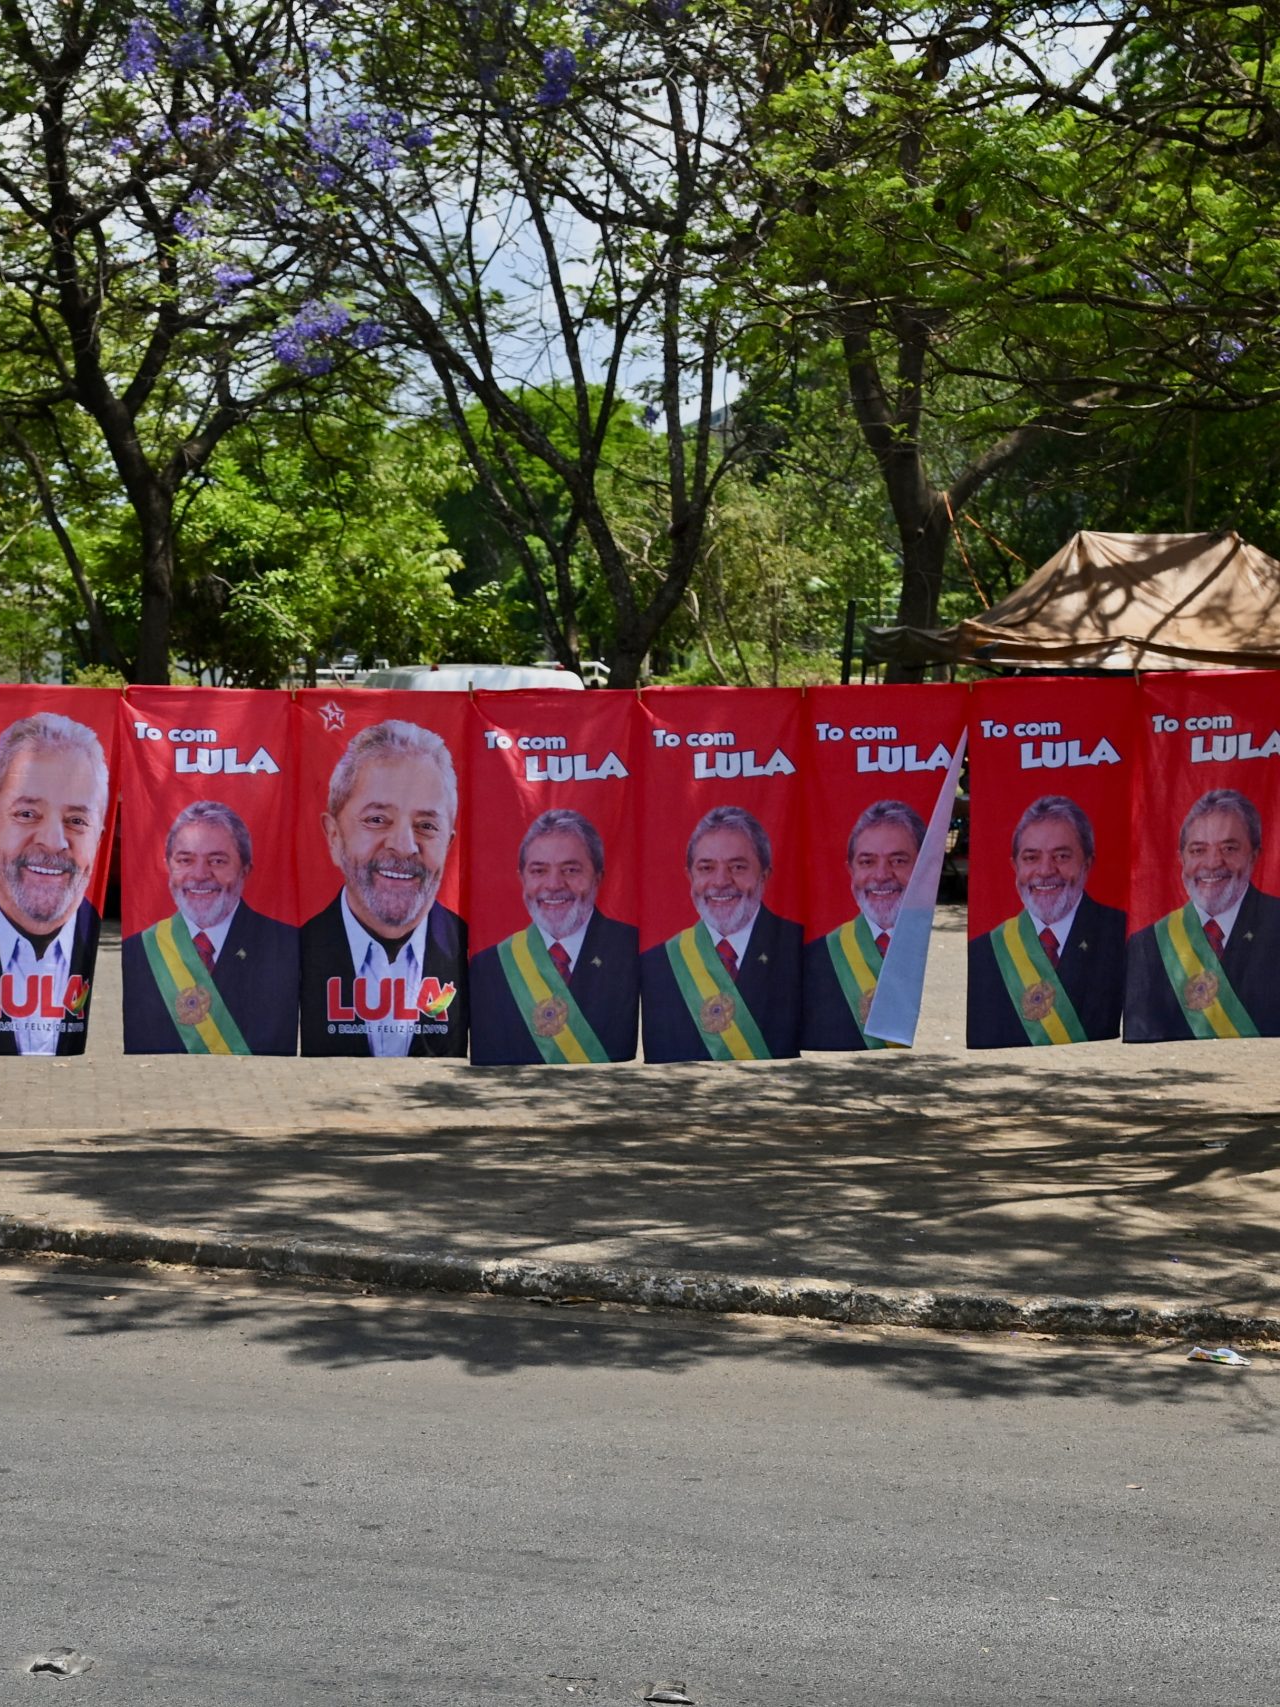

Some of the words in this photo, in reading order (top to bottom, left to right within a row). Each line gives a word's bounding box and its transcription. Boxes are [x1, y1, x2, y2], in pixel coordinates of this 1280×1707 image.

[329, 710, 341, 721] PT
[1152, 715, 1179, 733] To
[1185, 715, 1232, 731] com
[134, 722, 162, 741] To
[168, 729, 217, 742] com
[653, 730, 680, 747] To
[685, 731, 735, 747] com
[816, 723, 844, 741] To
[850, 726, 897, 740] com
[981, 720, 1008, 738] To
[1013, 722, 1061, 736] com
[484, 731, 512, 749] To
[518, 735, 566, 750] com
[1191, 729, 1280, 763] LULA
[175, 746, 280, 774] LULA
[857, 743, 953, 772] LULA
[1021, 737, 1121, 769] LULA
[525, 752, 629, 782] LULA
[693, 748, 796, 779] LULA
[327, 977, 454, 1021] LULA
[24, 1022, 51, 1031] FELIZ
[55, 1022, 66, 1032] DE
[328, 1024, 336, 1034] O
[377, 1024, 404, 1033] FELIZ
[409, 1024, 421, 1034] DE
